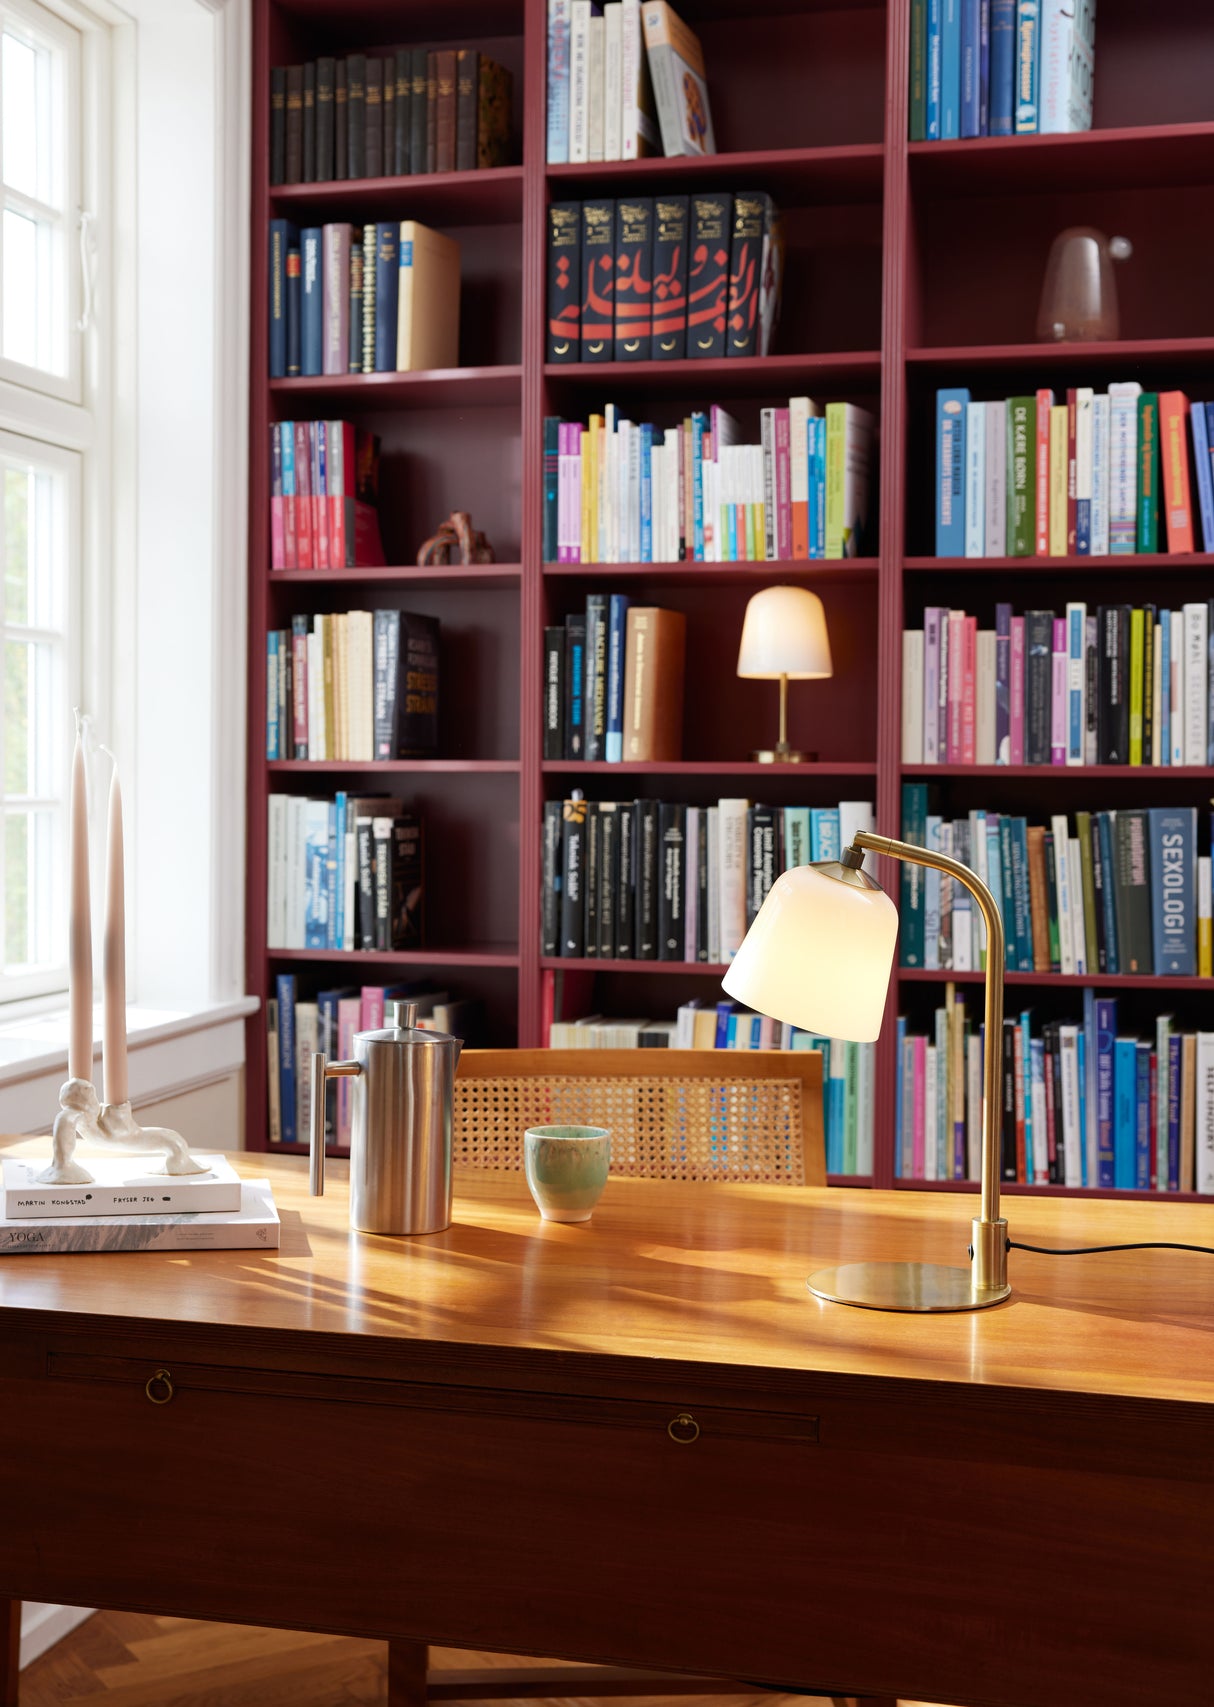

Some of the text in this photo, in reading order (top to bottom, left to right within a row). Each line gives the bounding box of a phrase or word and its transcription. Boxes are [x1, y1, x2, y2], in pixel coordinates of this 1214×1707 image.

[1015, 407, 1027, 422] DE
[1162, 834, 1185, 934] SEXOLOGI
[9, 1232, 45, 1242] YOGA
